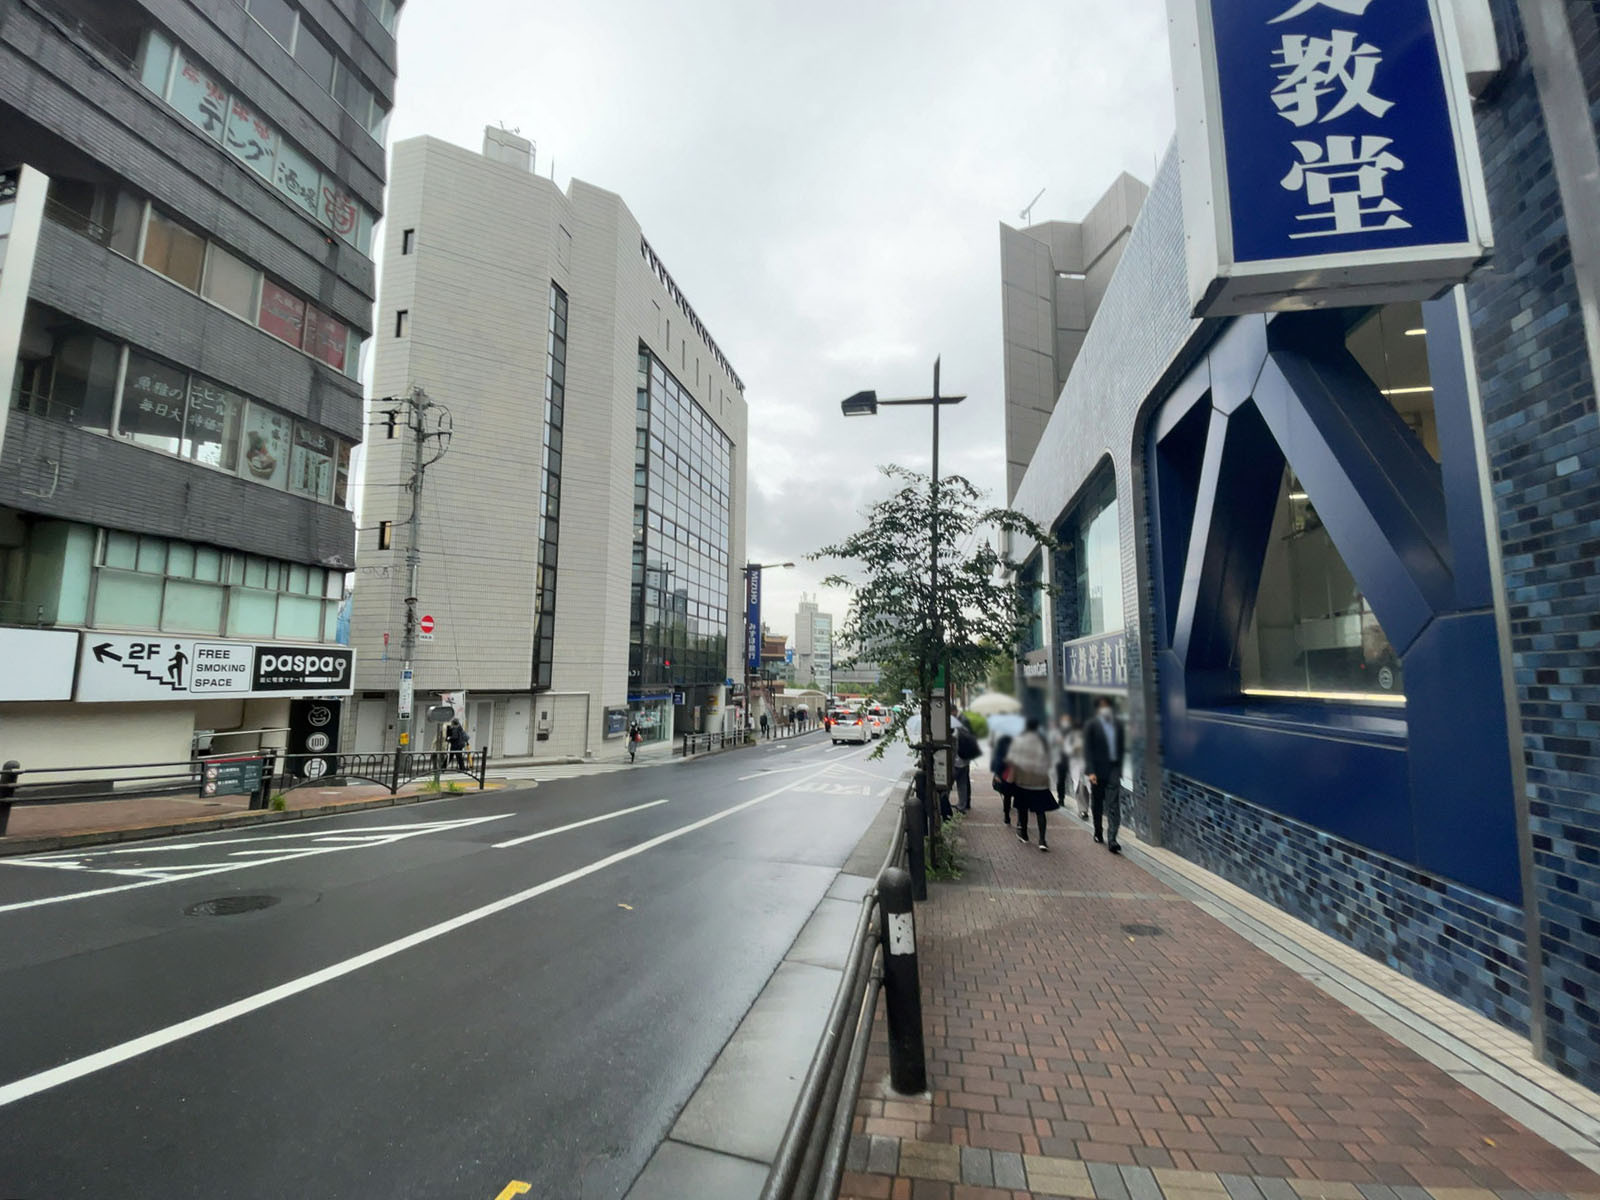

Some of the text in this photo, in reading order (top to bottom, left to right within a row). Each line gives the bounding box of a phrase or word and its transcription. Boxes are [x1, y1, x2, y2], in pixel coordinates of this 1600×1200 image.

[1266, 0, 1412, 240] 教堂
[751, 570, 759, 605] MIZUHO
[129, 643, 161, 660] 2F
[198, 649, 231, 659] FREE
[196, 663, 246, 673] SMOKING
[260, 655, 334, 675] paspa
[1068, 638, 1128, 684] 文教堂書店
[195, 678, 232, 687] SPACE
